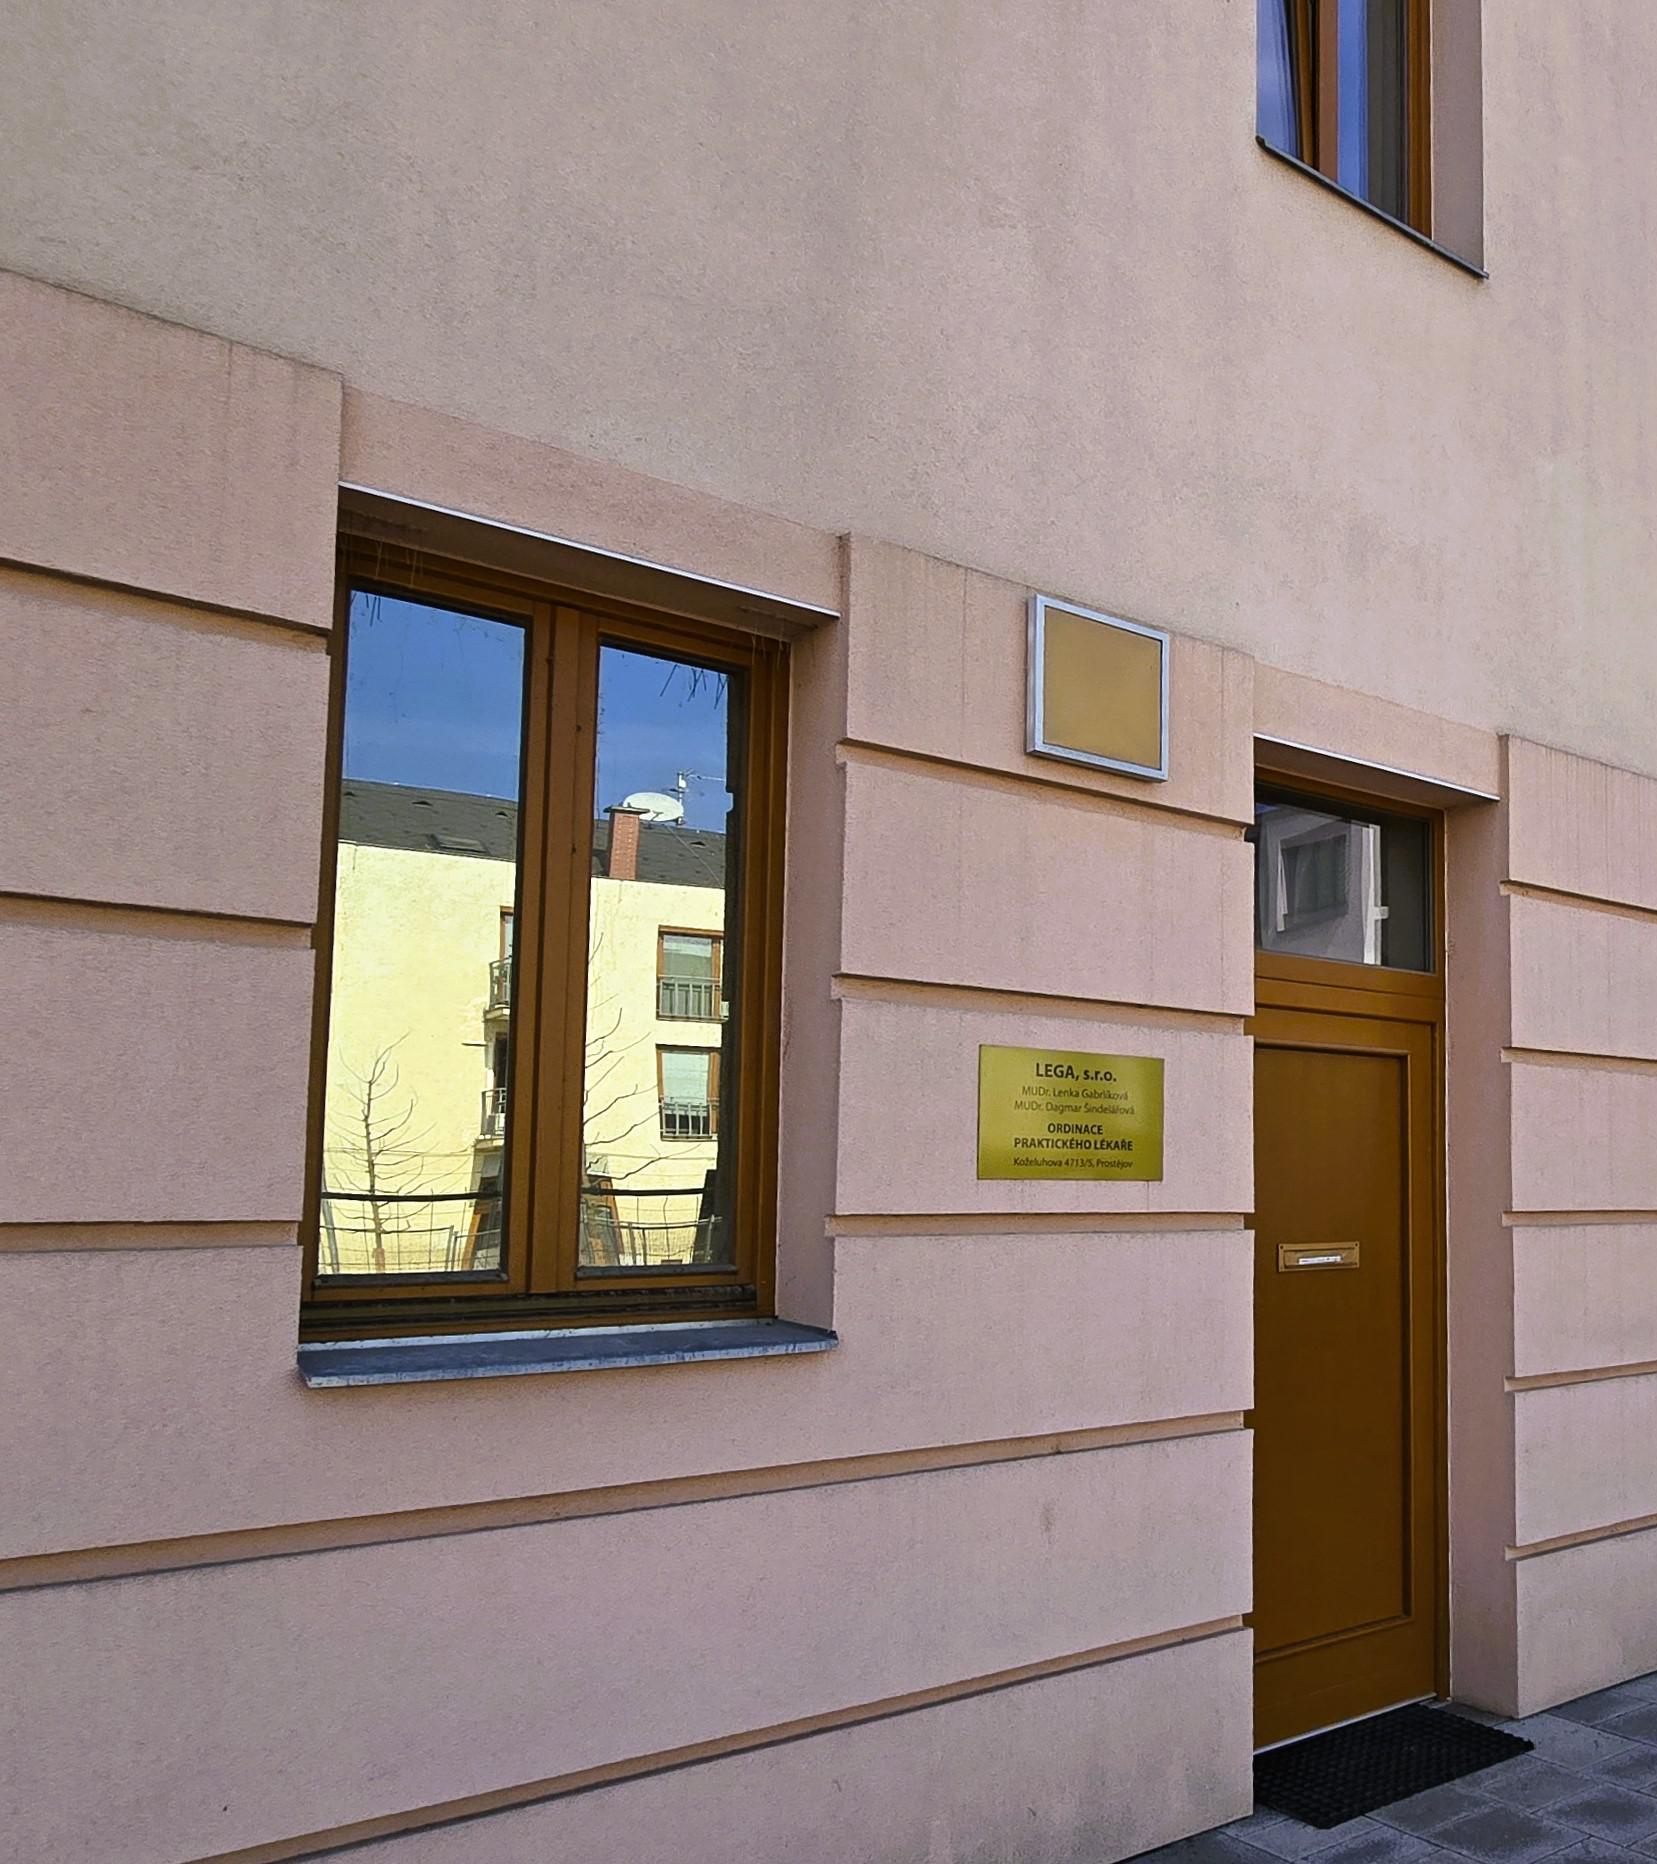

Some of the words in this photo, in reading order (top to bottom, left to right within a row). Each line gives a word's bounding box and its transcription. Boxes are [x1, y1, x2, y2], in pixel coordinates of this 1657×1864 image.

[1036, 1063, 1080, 1081] LEGA,
[1083, 1069, 1117, 1082] s.r.o.
[1022, 1086, 1050, 1097] MUDr.
[1053, 1088, 1079, 1098] Lenka
[1014, 1100, 1042, 1111] MUDr.
[1045, 1102, 1082, 1114] Dagmar
[1048, 1123, 1103, 1135] ORDINACE
[1014, 1138, 1091, 1150] PRAKTICKÉHO
[1094, 1138, 1133, 1151] LÉKAŘE
[1014, 1157, 1062, 1168] Koželuhova
[1096, 1158, 1133, 1170] Prostějov
